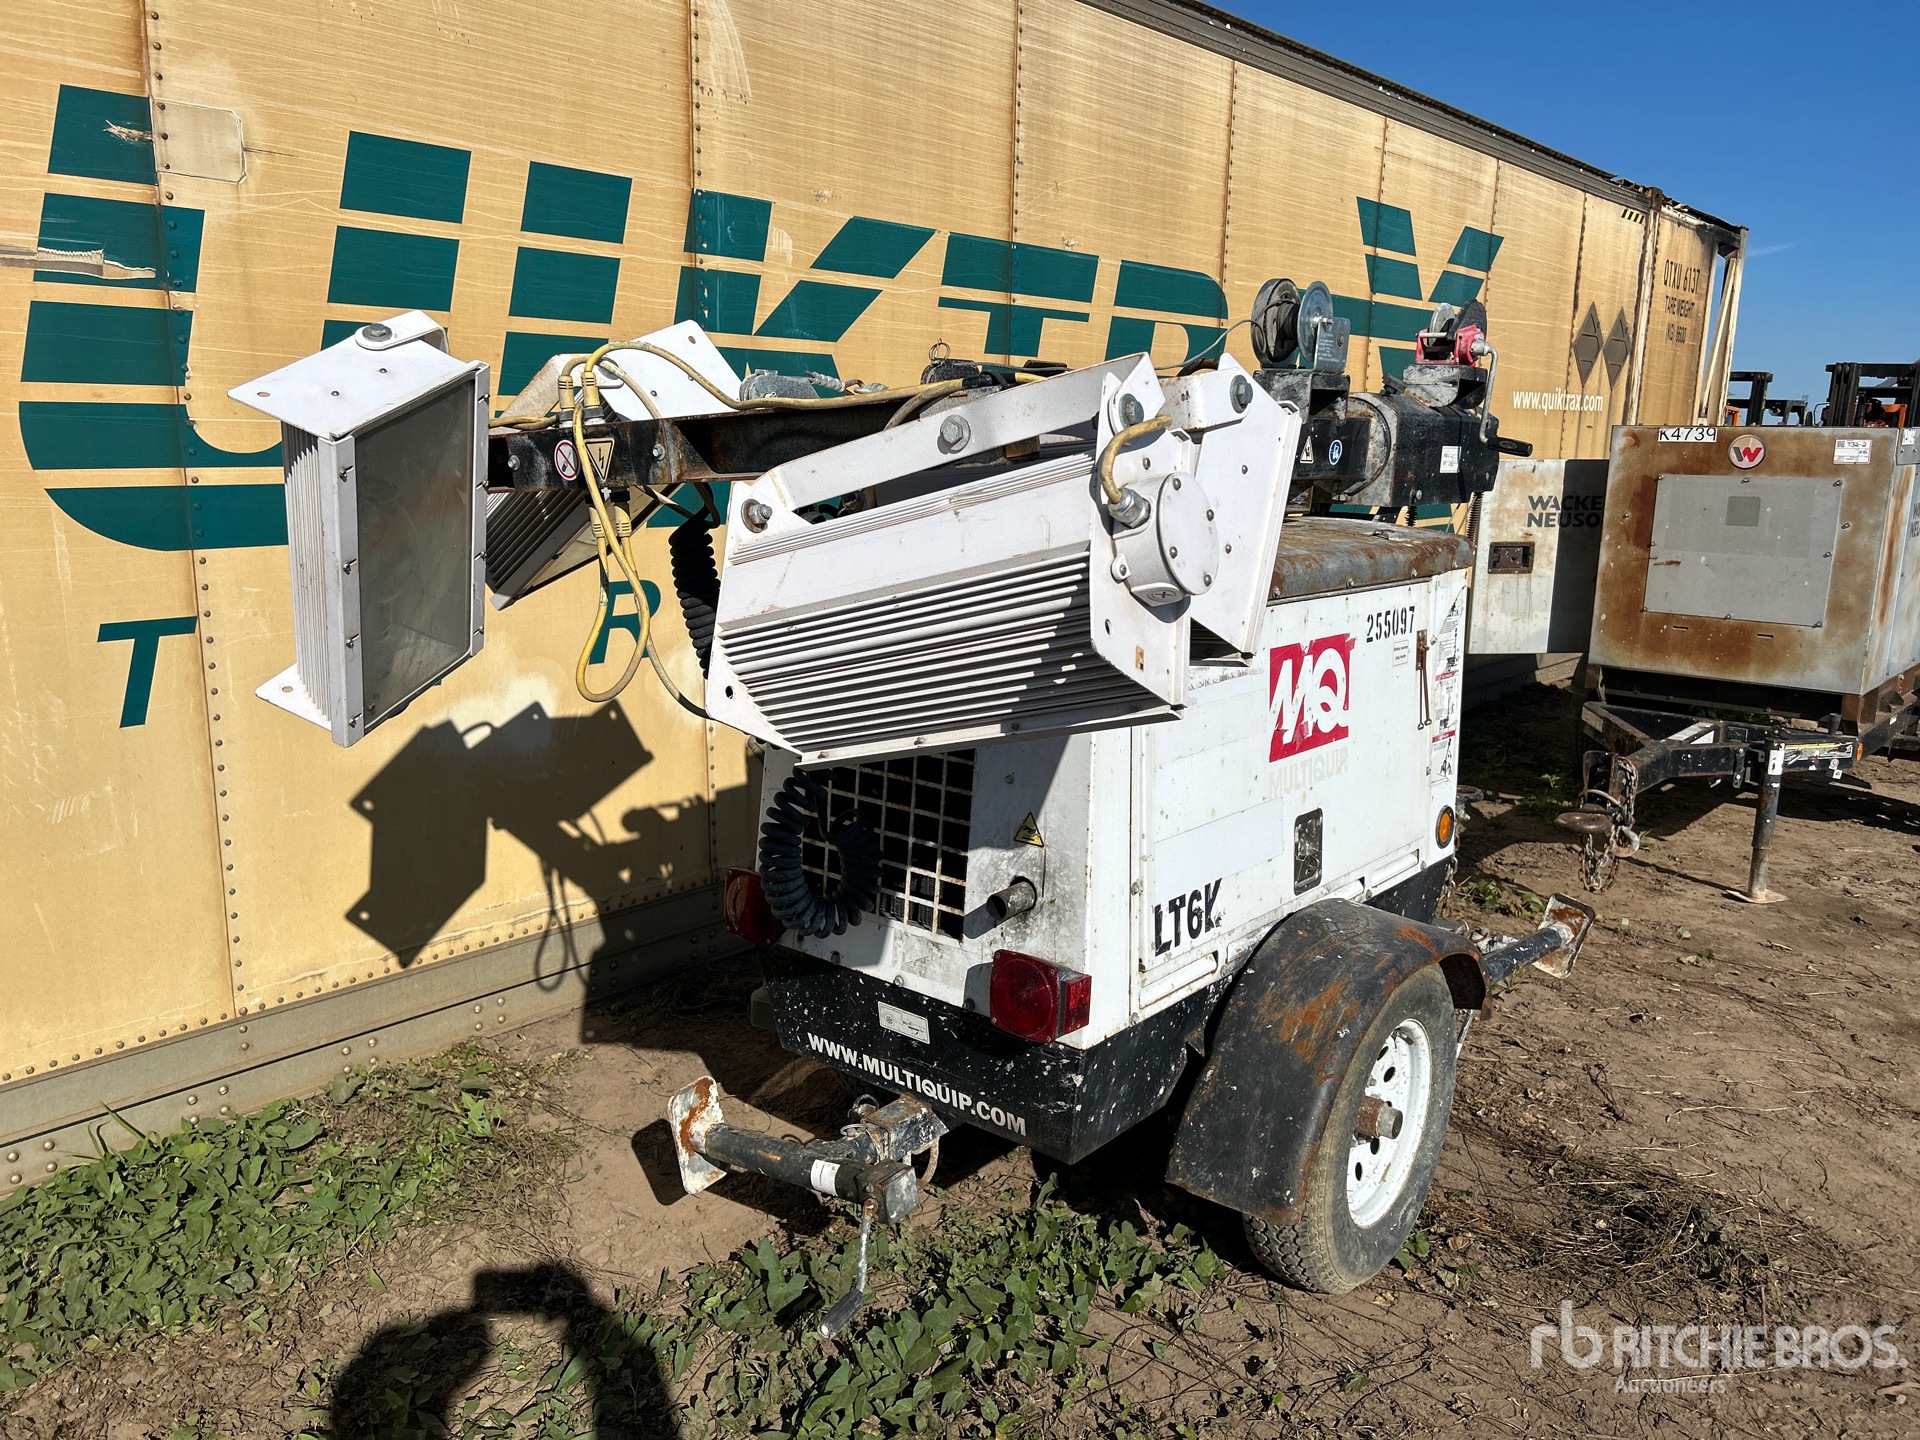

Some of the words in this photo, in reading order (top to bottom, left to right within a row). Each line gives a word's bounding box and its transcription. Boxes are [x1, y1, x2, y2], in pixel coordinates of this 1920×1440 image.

[1663, 259, 1682, 290] QTXU
[1683, 266, 1700, 293] 6137
[1665, 295, 1677, 315] TARE
[1513, 387, 1604, 416] www.quiktrax.com
[1660, 427, 1716, 441] K4739
[1528, 495, 1604, 511] WACKE
[1527, 512, 1601, 528] NEUSO
[1366, 605, 1415, 643] 255097
[1269, 645, 1349, 746] MQ
[1155, 878, 1222, 957] LT6K
[807, 1032, 1026, 1137] WWW.MULTIQUIP.COM
